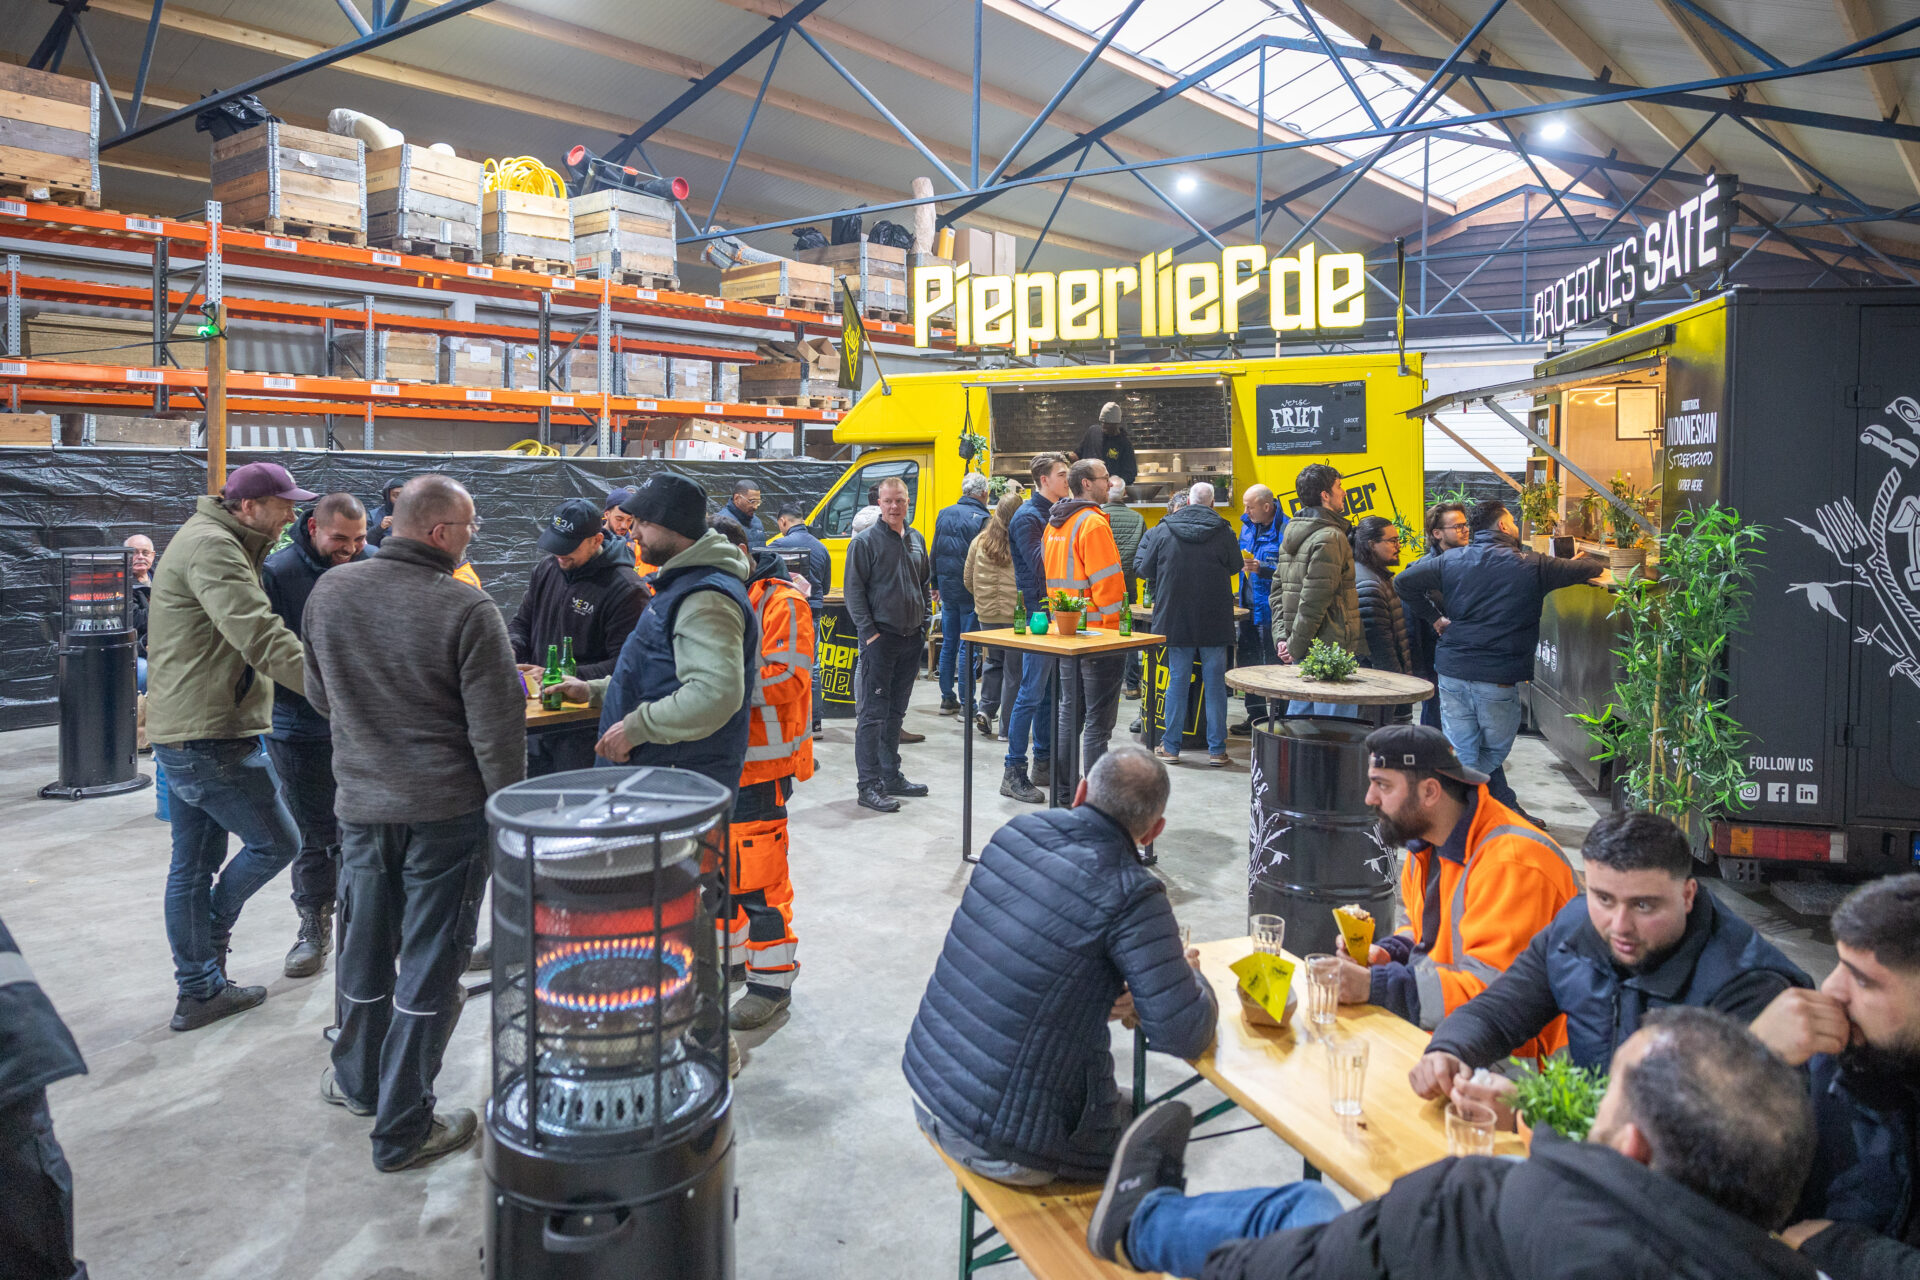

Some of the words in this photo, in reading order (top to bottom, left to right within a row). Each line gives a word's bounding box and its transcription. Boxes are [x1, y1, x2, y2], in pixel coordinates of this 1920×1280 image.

[1534, 236, 1637, 341] BROERTJES
[1644, 174, 1719, 291] SATÉ
[914, 241, 1365, 356] Pieperliefde
[1281, 399, 1311, 407] verse
[1270, 405, 1323, 429] FRIET
[1667, 412, 1717, 446] INDONESIAN
[1691, 479, 1703, 491] HERE
[1749, 756, 1795, 771] FOLLOW
[1798, 758, 1814, 772] US
